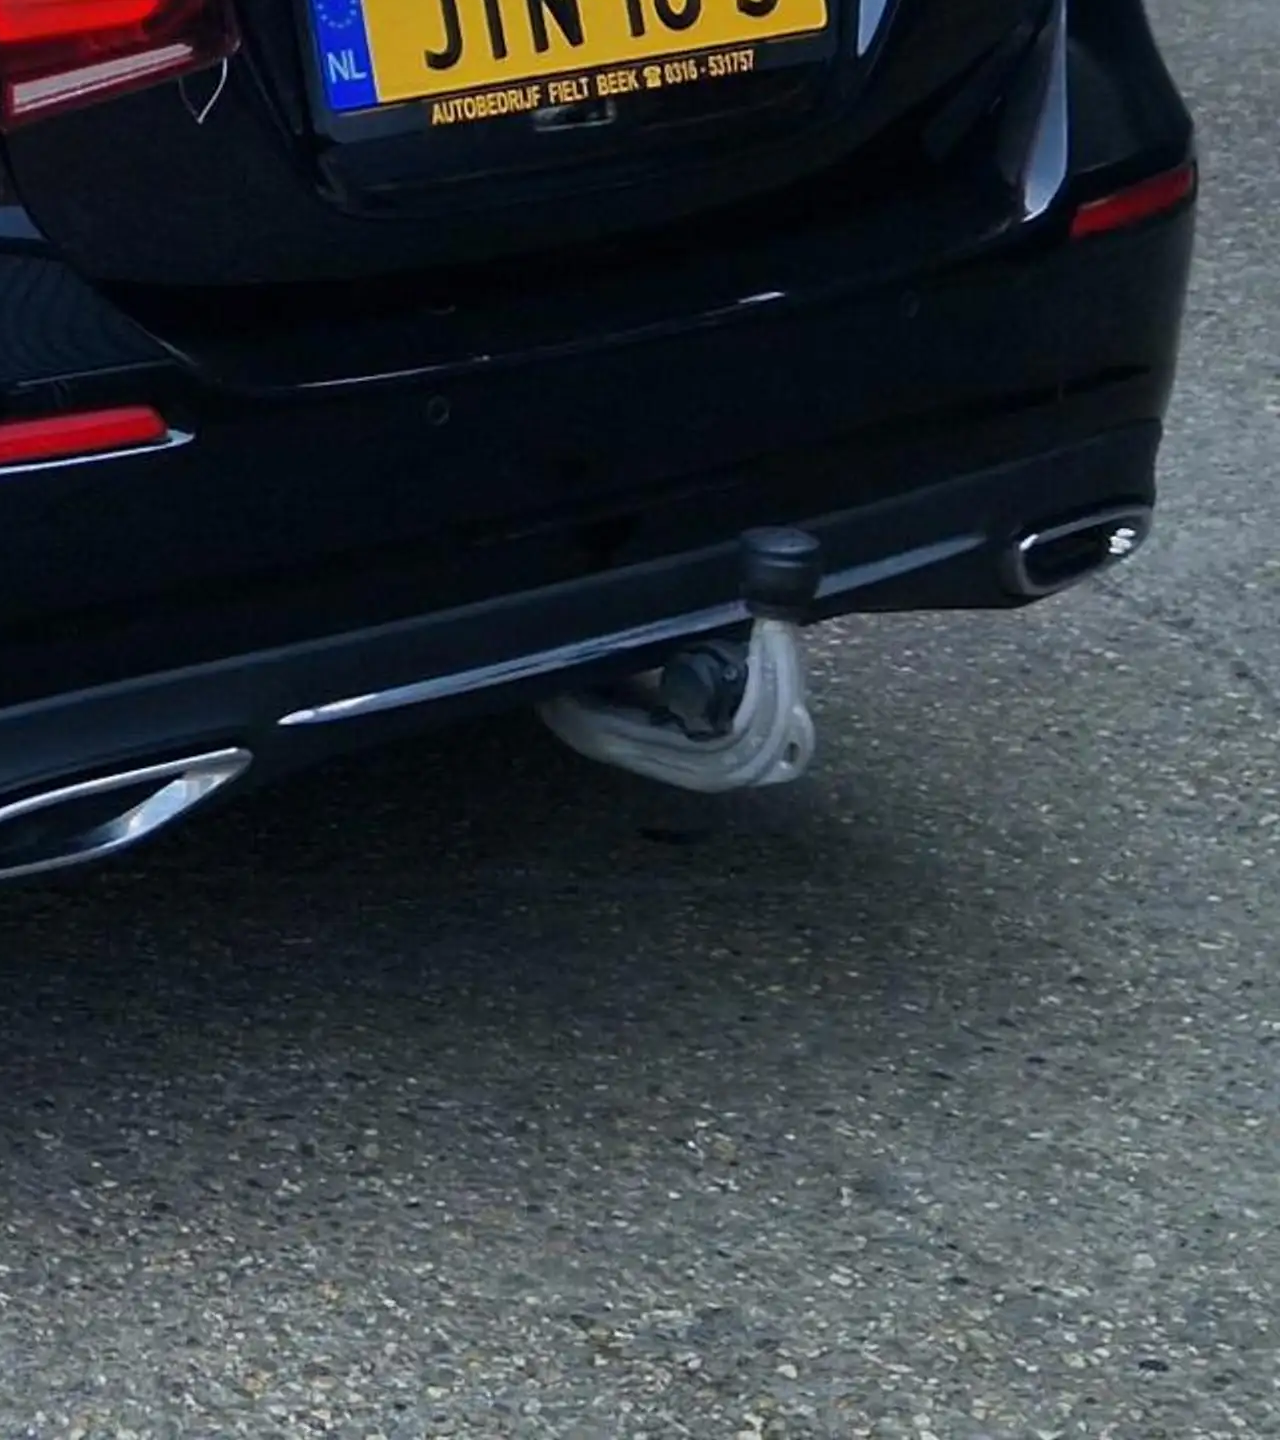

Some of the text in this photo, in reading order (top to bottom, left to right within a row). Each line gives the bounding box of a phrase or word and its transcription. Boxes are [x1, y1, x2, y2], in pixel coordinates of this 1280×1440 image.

[326, 48, 368, 85] NL
[431, 87, 542, 126] AUTOBEDRIJF
[548, 77, 590, 105] FIELT
[597, 70, 640, 97] BEEK
[664, 58, 698, 84] 0316
[708, 49, 756, 76] 531757
